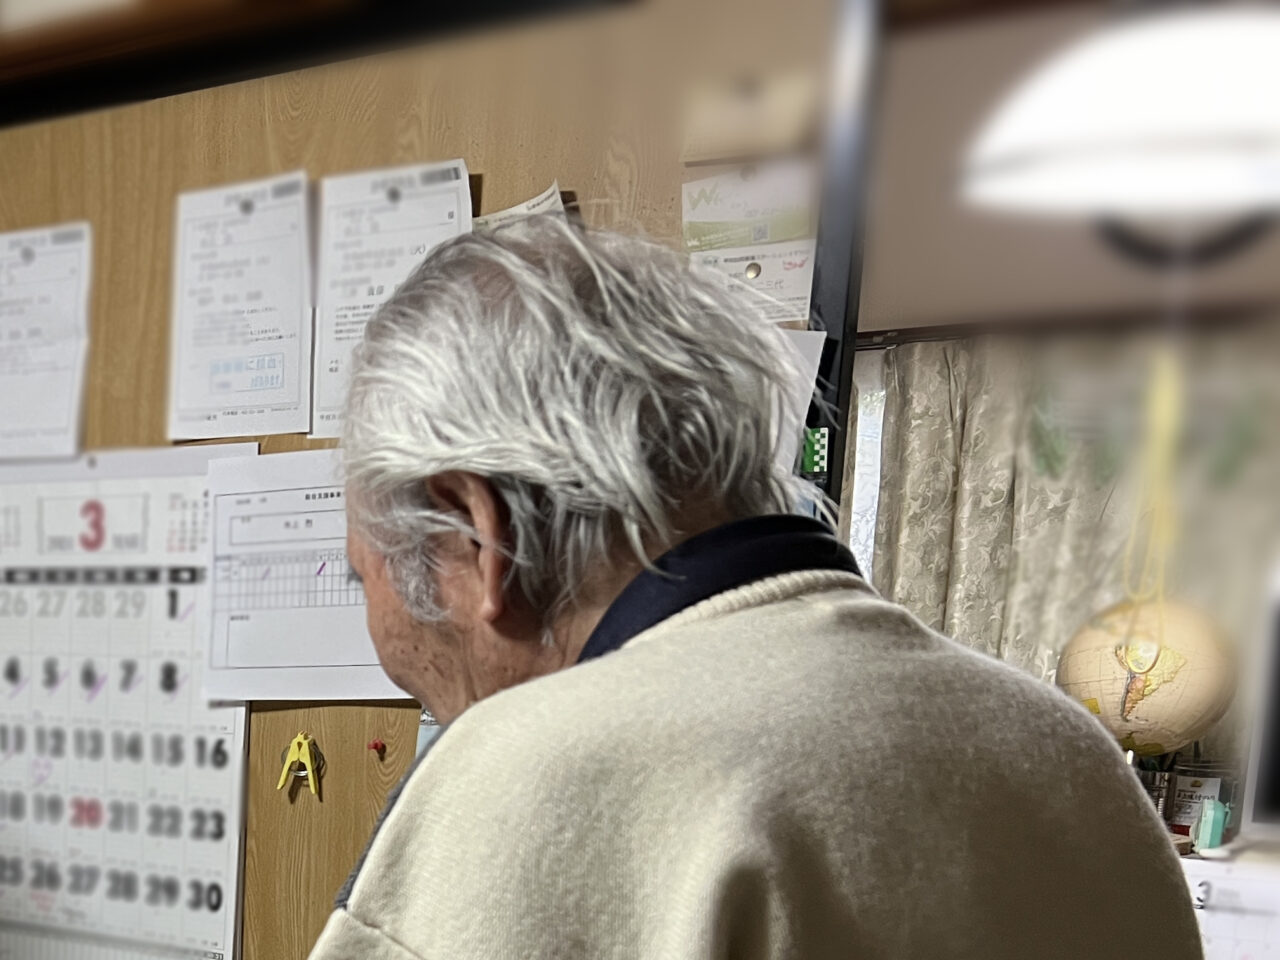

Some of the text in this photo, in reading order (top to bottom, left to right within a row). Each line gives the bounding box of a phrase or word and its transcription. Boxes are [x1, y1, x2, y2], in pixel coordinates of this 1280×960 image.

[80, 499, 105, 551] 3
[36, 590, 67, 617] 27
[76, 590, 106, 617] 28
[114, 591, 146, 617] 29
[168, 589, 178, 619] 1
[3, 656, 21, 684] 4
[42, 656, 59, 688] 5
[80, 659, 98, 689] 6
[119, 660, 137, 692] 7
[160, 661, 178, 693] 8
[35, 725, 66, 758] 12
[73, 726, 105, 761] 13
[112, 730, 143, 764] 14
[151, 732, 184, 767] 15
[194, 737, 228, 770] 16
[33, 793, 64, 825] 19
[70, 796, 103, 829] 20
[107, 799, 139, 832] 21
[146, 803, 183, 838] 22
[189, 808, 225, 841] 23
[30, 859, 61, 891] 26
[69, 864, 100, 896] 27
[106, 868, 138, 902] 28
[145, 874, 180, 907] 29
[187, 879, 223, 913] 30
